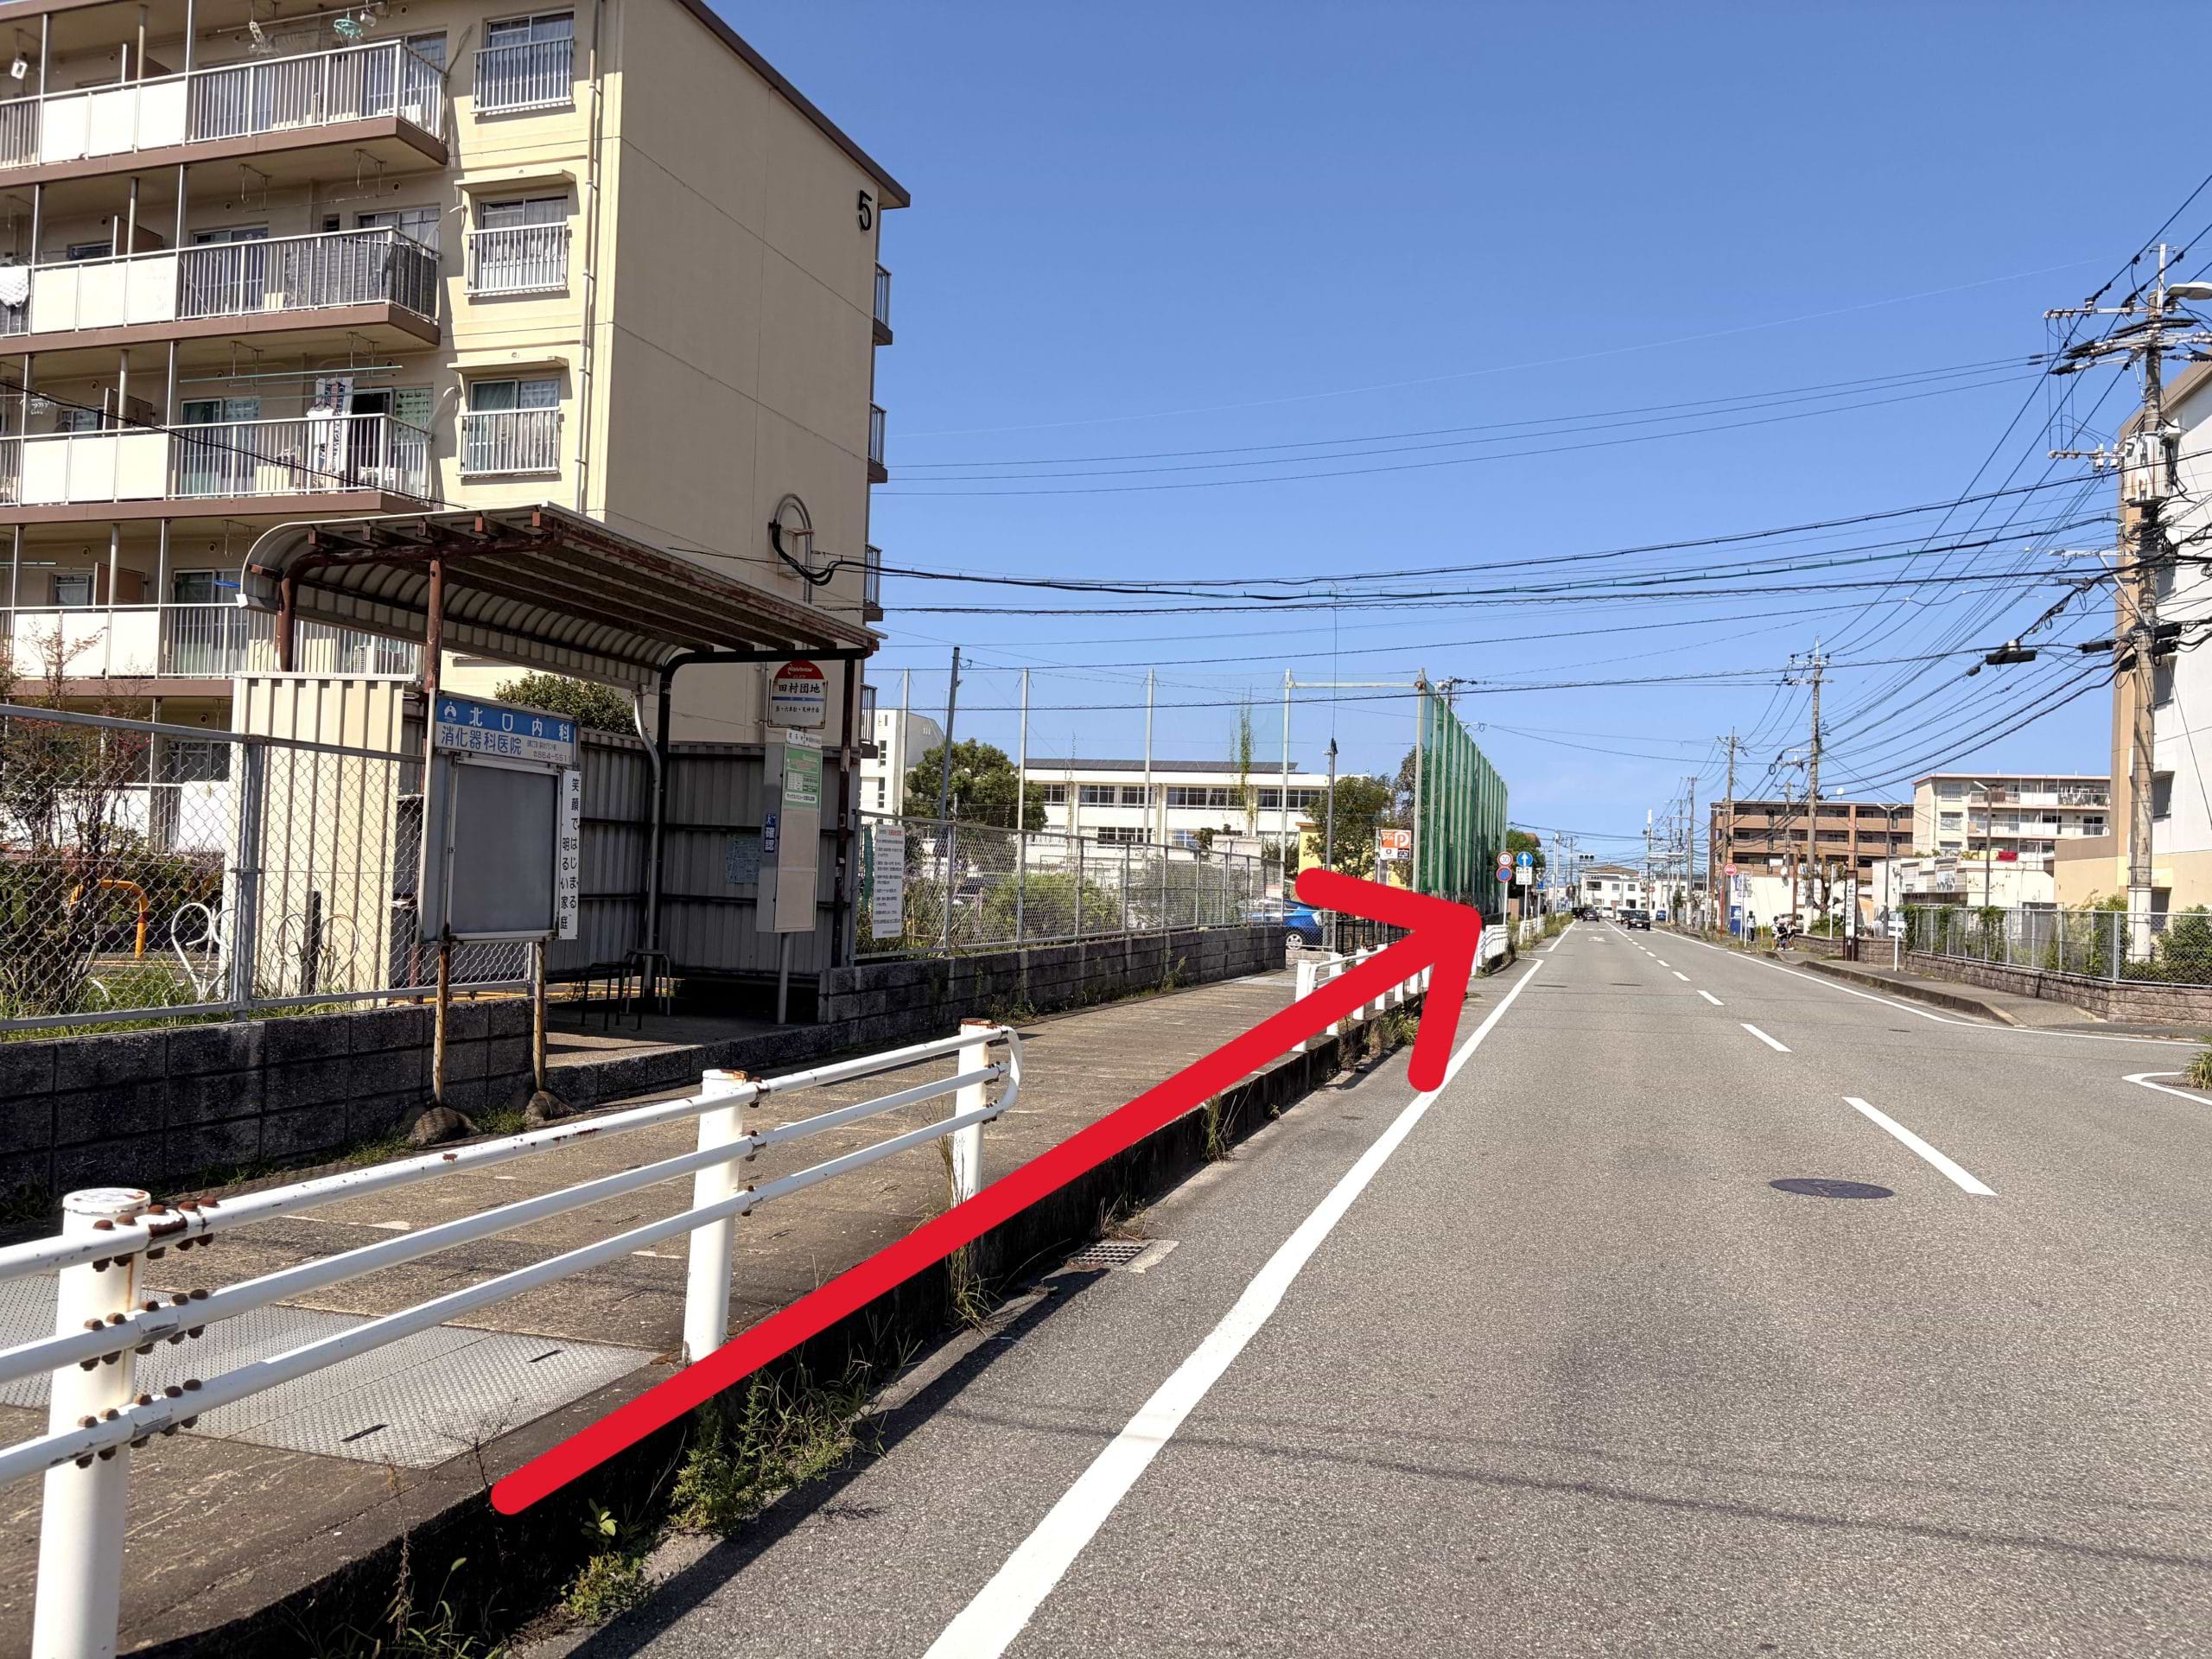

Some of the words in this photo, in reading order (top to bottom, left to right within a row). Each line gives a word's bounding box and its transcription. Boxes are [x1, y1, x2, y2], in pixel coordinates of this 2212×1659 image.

[858, 190, 873, 231] 5
[779, 683, 821, 694] 田村団地
[441, 725, 522, 755] 消化器科医院
[469, 707, 570, 742] 北口内科
[569, 778, 580, 909] 笑顔ではじまる
[1394, 831, 1409, 848] P
[559, 836, 570, 930] 明るい家庭
